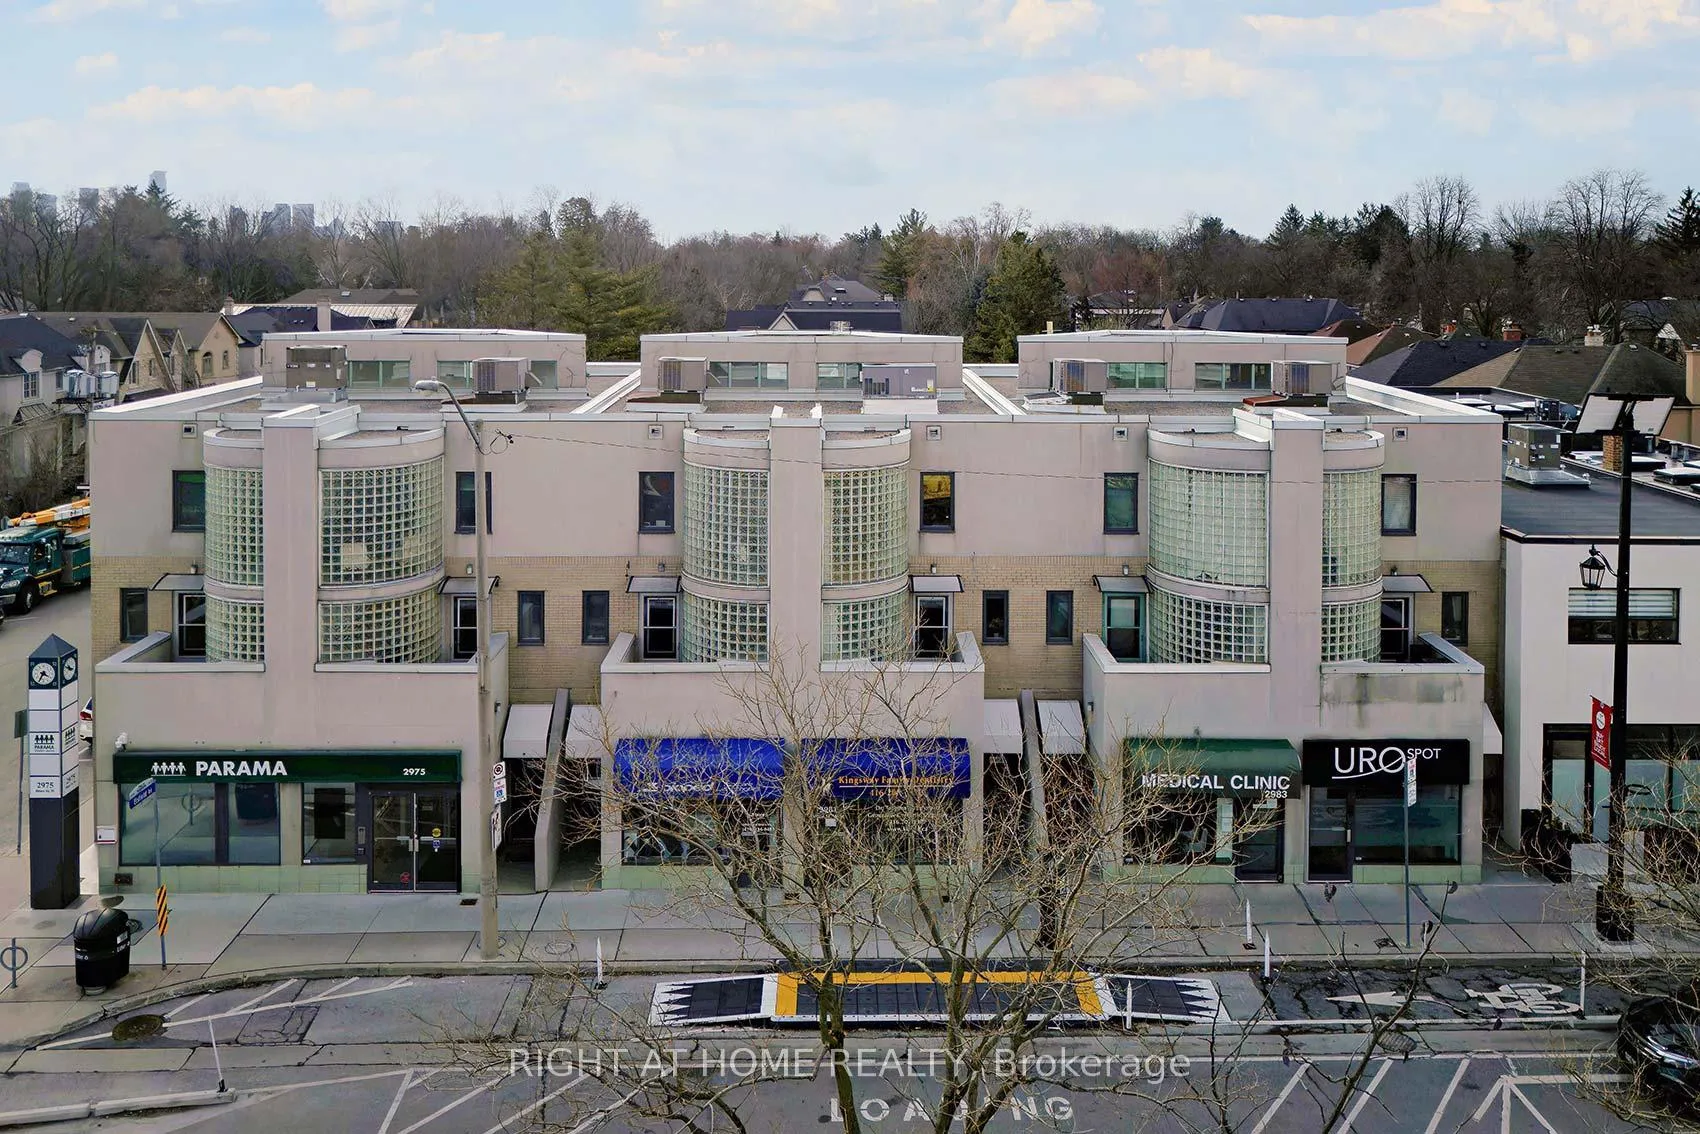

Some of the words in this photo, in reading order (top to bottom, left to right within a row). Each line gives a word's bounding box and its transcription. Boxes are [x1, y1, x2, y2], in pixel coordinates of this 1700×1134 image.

[1334, 746, 1406, 774] URO
[1407, 748, 1441, 760] SPOT
[195, 760, 288, 776] PARAMA
[402, 768, 426, 776] 2975
[37, 781, 54, 789] 2975
[838, 776, 880, 786] Kingsway
[1141, 774, 1224, 789] MEDICAL
[1230, 775, 1290, 790] CLINIC
[1264, 790, 1288, 799] 2983
[830, 1096, 1074, 1122] LOANG
